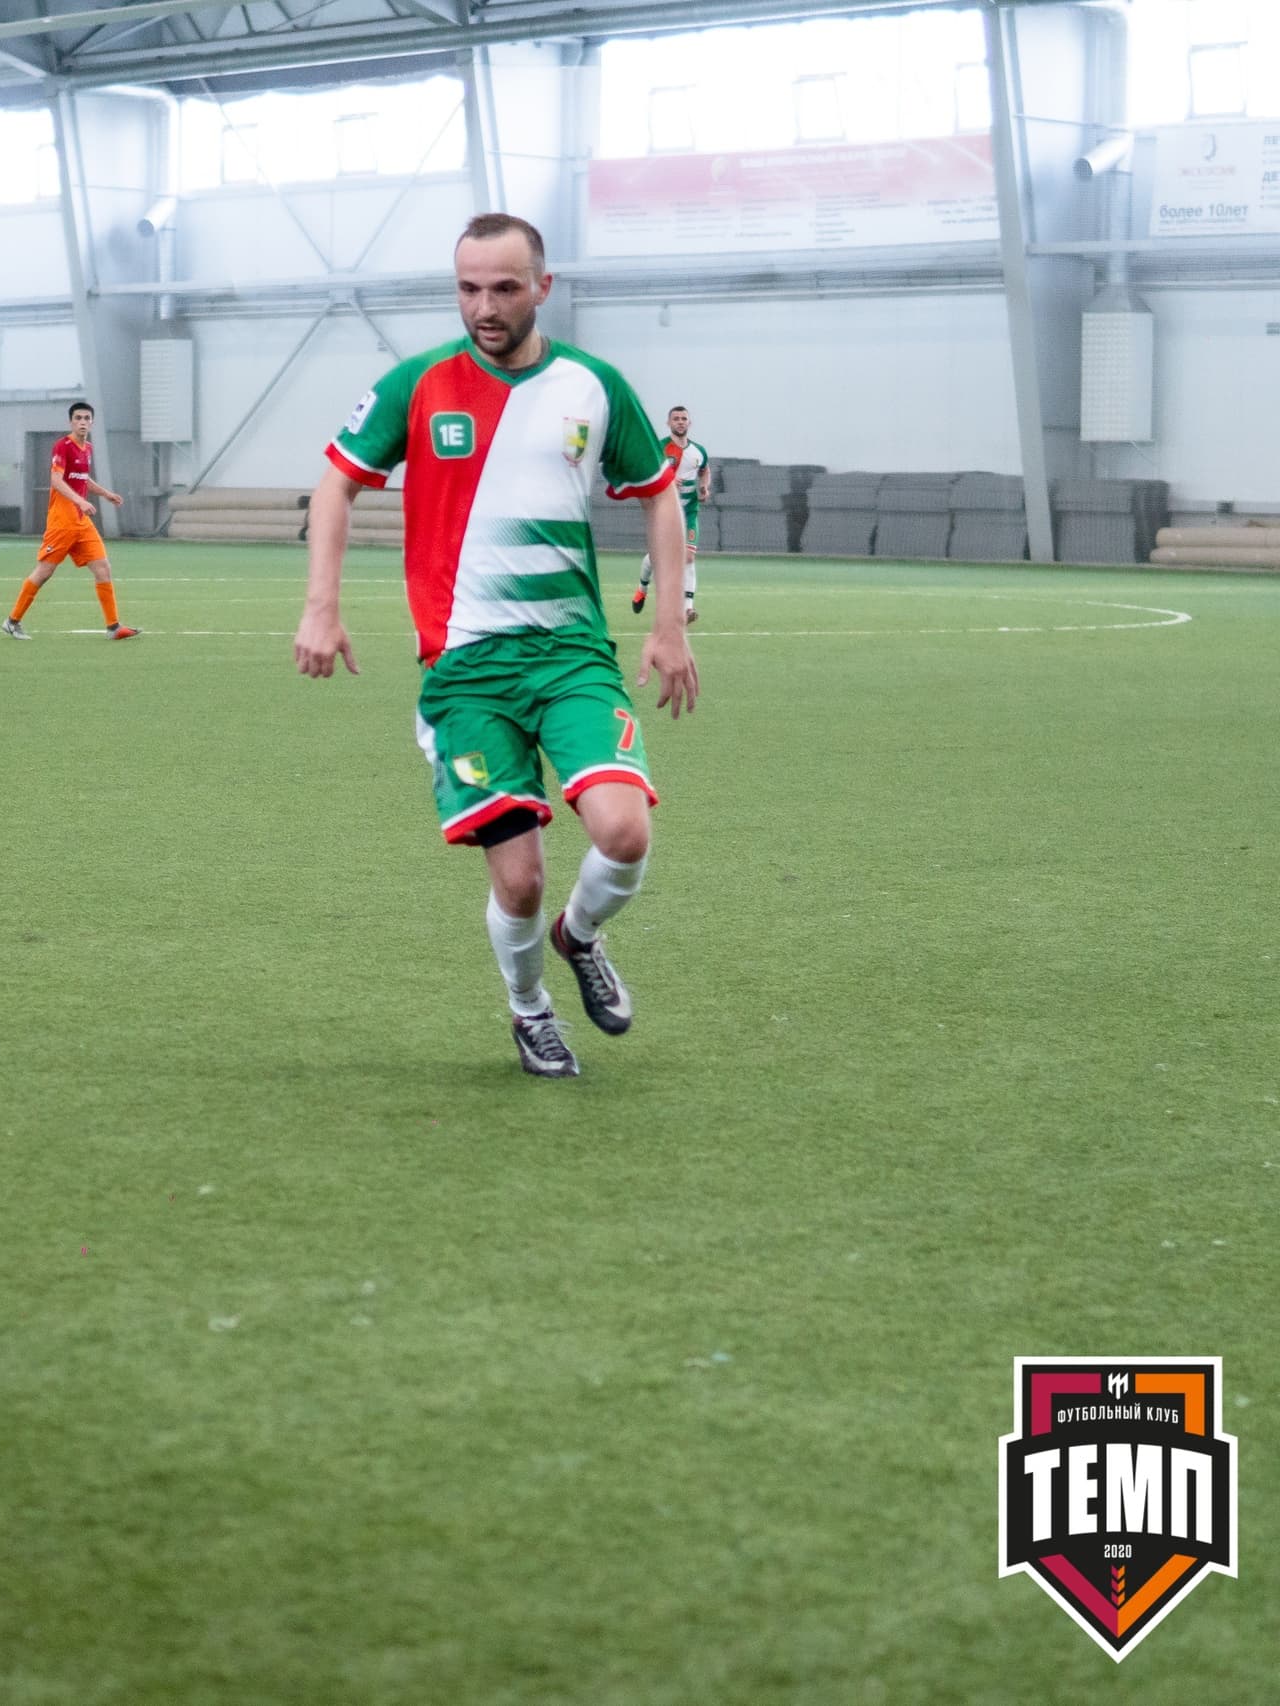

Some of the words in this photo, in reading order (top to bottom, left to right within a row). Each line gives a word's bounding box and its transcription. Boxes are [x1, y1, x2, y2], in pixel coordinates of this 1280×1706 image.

[1158, 203, 1204, 219] более
[439, 423, 465, 447] 1E
[614, 707, 636, 752] 7
